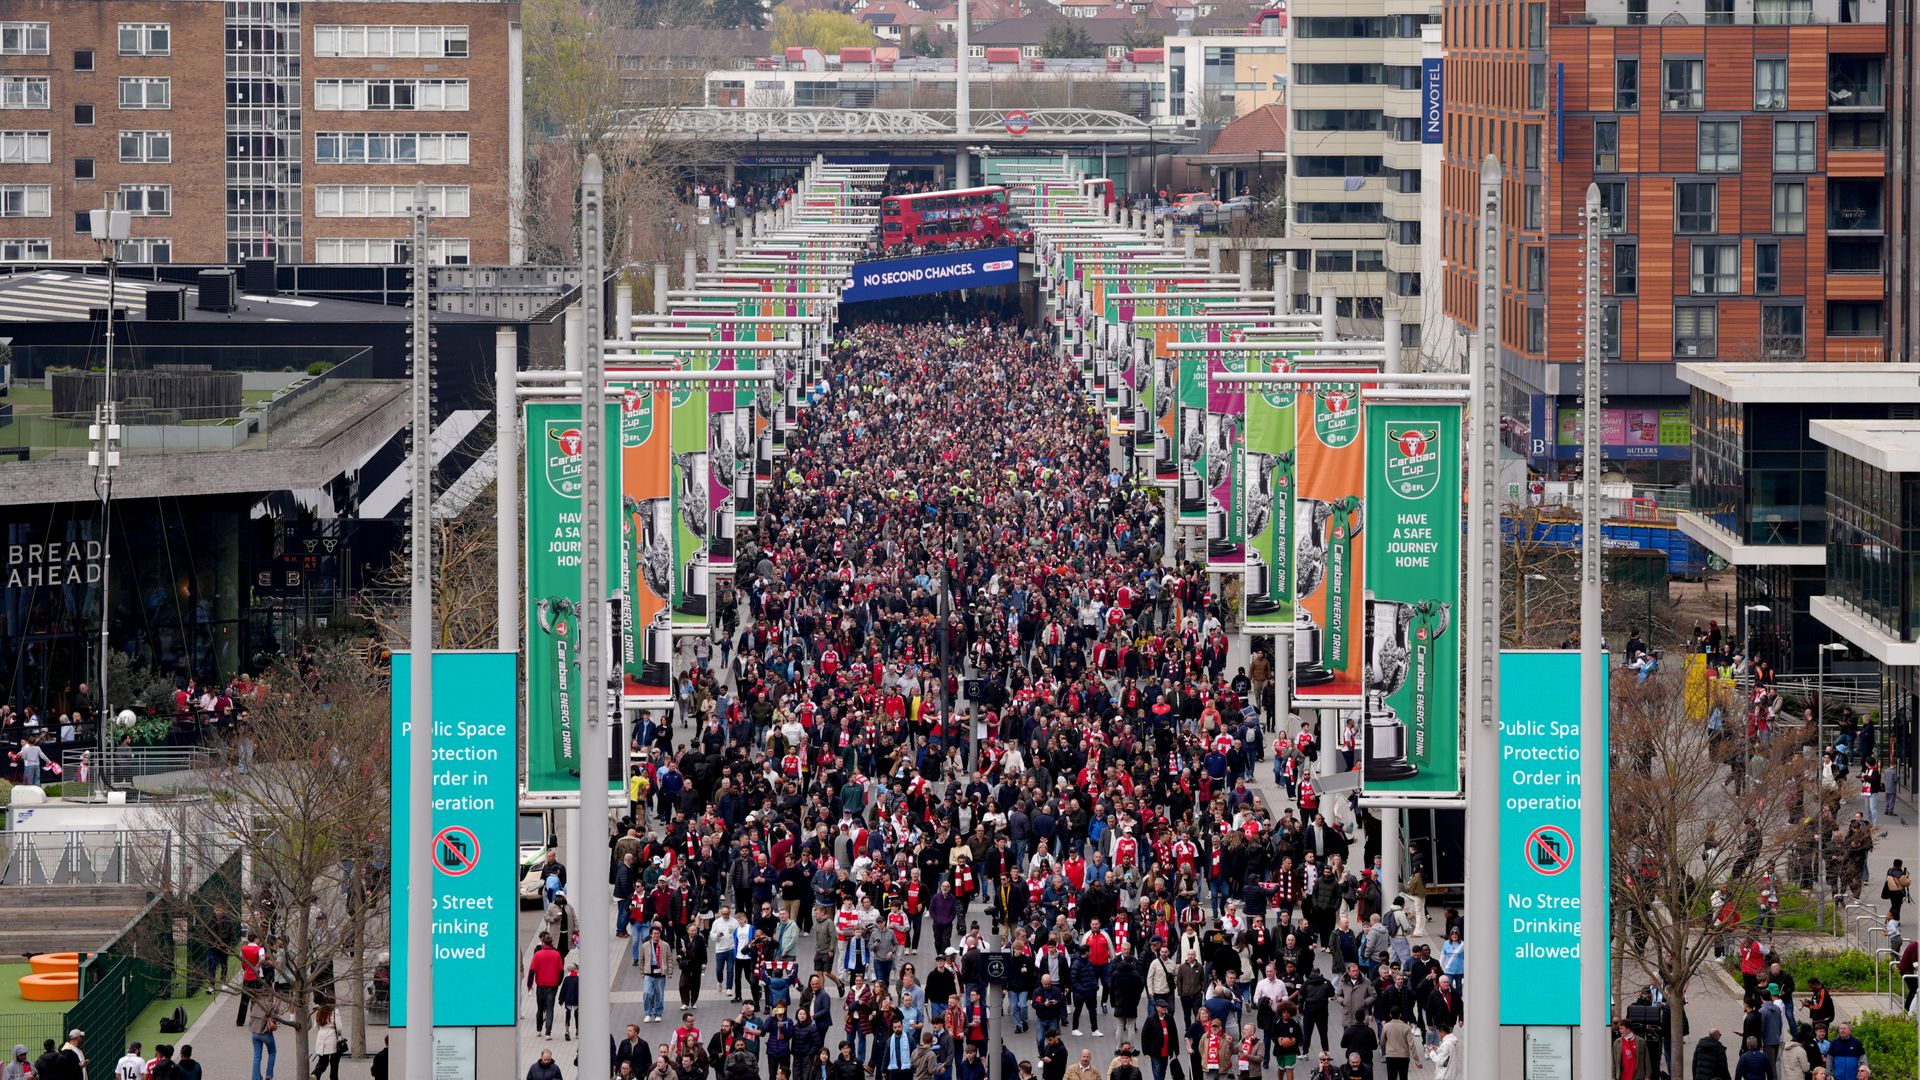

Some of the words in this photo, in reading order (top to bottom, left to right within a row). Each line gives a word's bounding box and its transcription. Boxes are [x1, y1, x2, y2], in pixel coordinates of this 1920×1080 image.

[1428, 64, 1440, 132] NOVOTEL
[845, 112, 930, 133] PARK
[864, 274, 880, 286] NO
[882, 269, 923, 284] SECOND
[924, 263, 976, 280] CHANCES.
[1318, 408, 1356, 422] Carabao
[1328, 419, 1346, 429] Cup
[1532, 439, 1544, 454] B
[550, 452, 582, 468] Carab
[1390, 452, 1436, 468] Carabao
[1402, 465, 1423, 476] Cup
[559, 513, 582, 523] HAV
[1278, 492, 1287, 535] Carabao
[1398, 514, 1427, 524] HAVE
[554, 528, 563, 538] A
[1393, 528, 1401, 539] A
[1404, 528, 1432, 539] SAFE
[9, 541, 101, 564] BREAD
[1278, 537, 1286, 569] ENERGY
[1386, 542, 1438, 553] JOURNEY
[558, 556, 582, 566] HOM
[1334, 544, 1344, 594] Carabao
[1396, 557, 1429, 567] HOME
[8, 564, 101, 588] AHEAD
[286, 571, 300, 586] B
[623, 594, 632, 631] ENERGY
[1333, 596, 1342, 632] ENERGY
[626, 634, 634, 663] DRINK
[1332, 634, 1342, 662] DRINK
[557, 640, 568, 690] Carabao
[1417, 645, 1426, 692] Carabao
[560, 692, 570, 731] ENERGY
[1416, 694, 1426, 728] ENERGY
[402, 721, 452, 736] Plic
[457, 722, 506, 740] Space
[1550, 721, 1580, 740] Spa
[563, 734, 573, 759] DRINK
[1416, 730, 1424, 757] DRINK
[1504, 746, 1580, 760] Protectio
[434, 770, 468, 785] rder
[474, 770, 488, 785] in
[1512, 770, 1561, 785] Order
[1567, 770, 1580, 785] in
[432, 796, 494, 810] eration
[443, 895, 493, 909] Street
[1509, 894, 1532, 908] No
[1537, 894, 1580, 908] Stree
[432, 920, 488, 937] rinking
[1513, 918, 1581, 936] Drinking
[436, 944, 486, 959] lowed
[1515, 943, 1580, 958] allowed
[123, 1067, 137, 1080] 14
